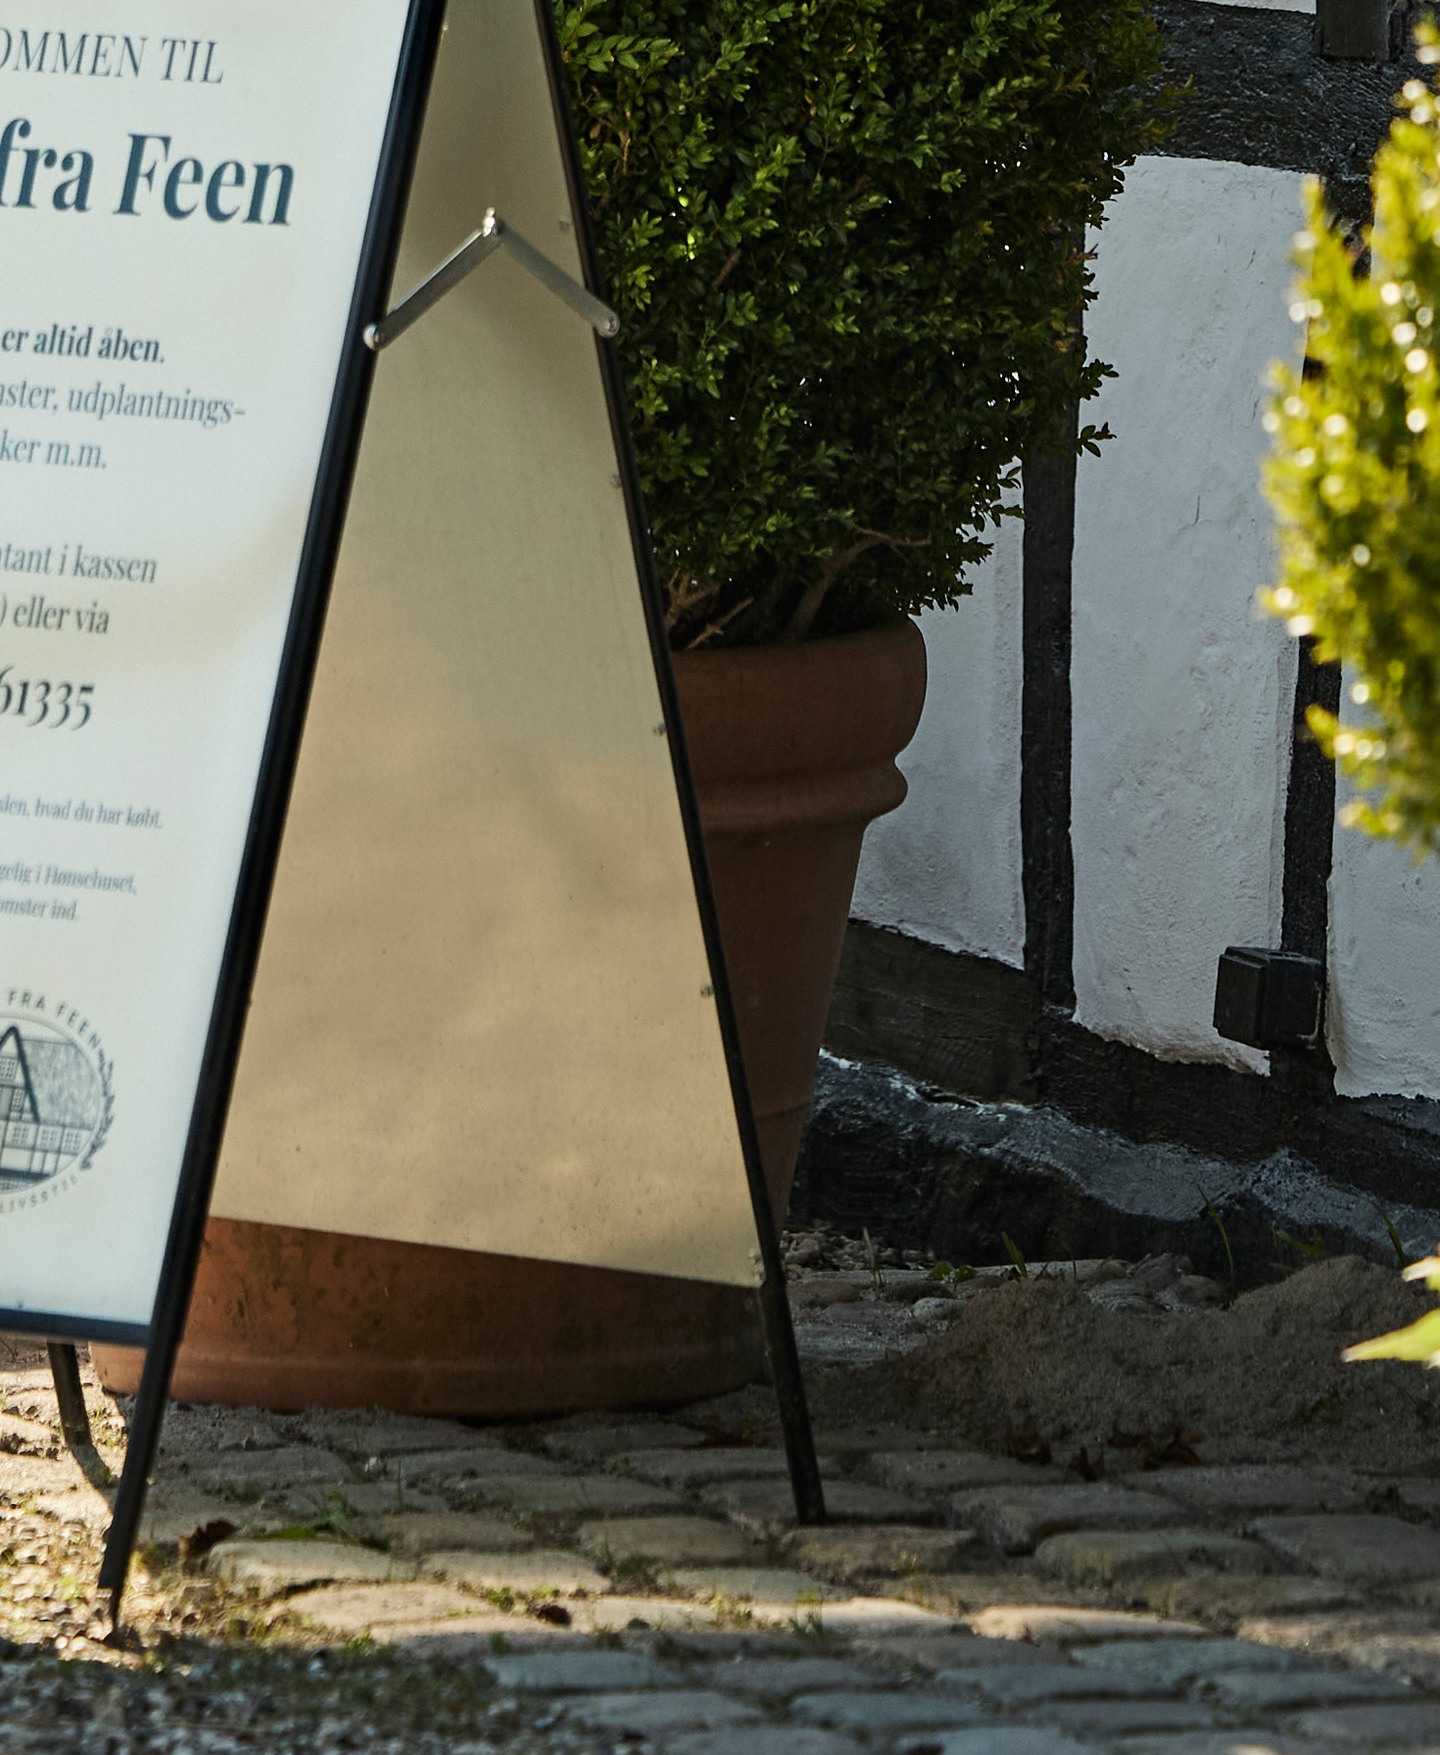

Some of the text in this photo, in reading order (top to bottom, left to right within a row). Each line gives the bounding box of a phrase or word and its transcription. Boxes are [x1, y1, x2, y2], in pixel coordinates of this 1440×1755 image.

[159, 38, 225, 84] TIL
[112, 132, 296, 226] Feen
[0, 326, 30, 353] er
[32, 323, 93, 359] altid
[97, 325, 166, 364] åben.
[67, 382, 246, 429] udplantnings-
[46, 441, 108, 469] m.m.
[58, 545, 70, 576] i
[72, 545, 158, 584] kassen
[13, 595, 71, 631] eller
[74, 601, 111, 635] via
[34, 796, 71, 821] hvad
[74, 800, 94, 823] du
[96, 802, 124, 826] har
[50, 899, 80, 922] ind.
[6, 987, 47, 1012] FRA
[56, 1000, 103, 1050] FEEN
